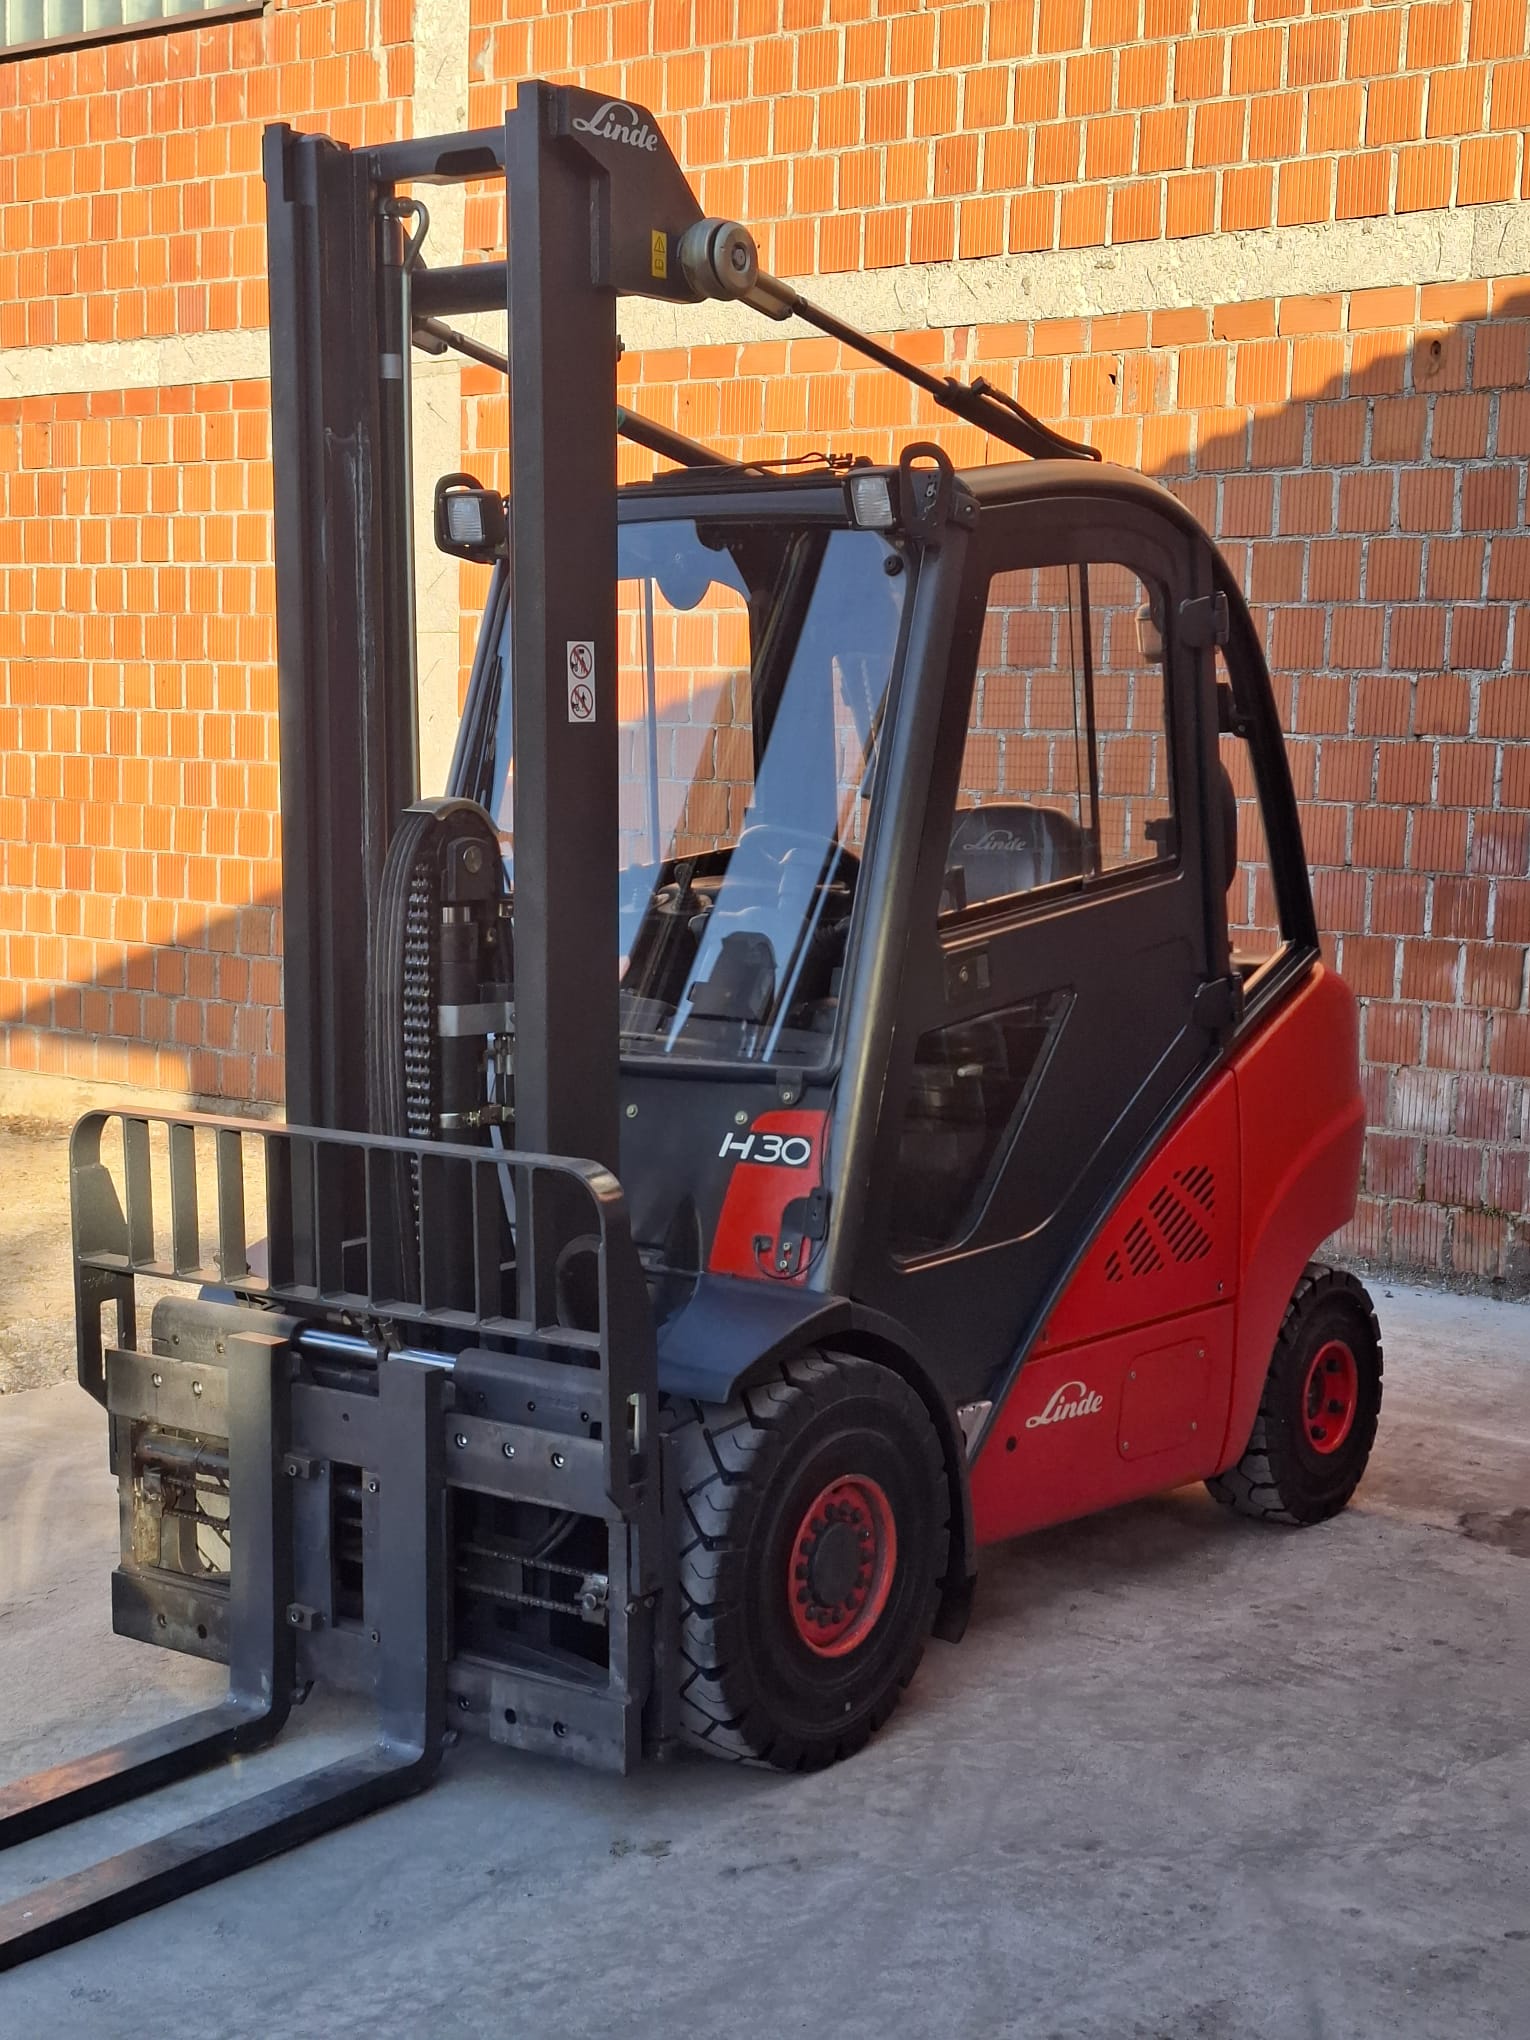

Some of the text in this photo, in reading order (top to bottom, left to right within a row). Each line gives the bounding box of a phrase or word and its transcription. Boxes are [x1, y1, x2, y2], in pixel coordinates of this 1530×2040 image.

[572, 101, 658, 151] Linde
[963, 829, 1026, 851] Linde
[1025, 1381, 1103, 1428] Linde
